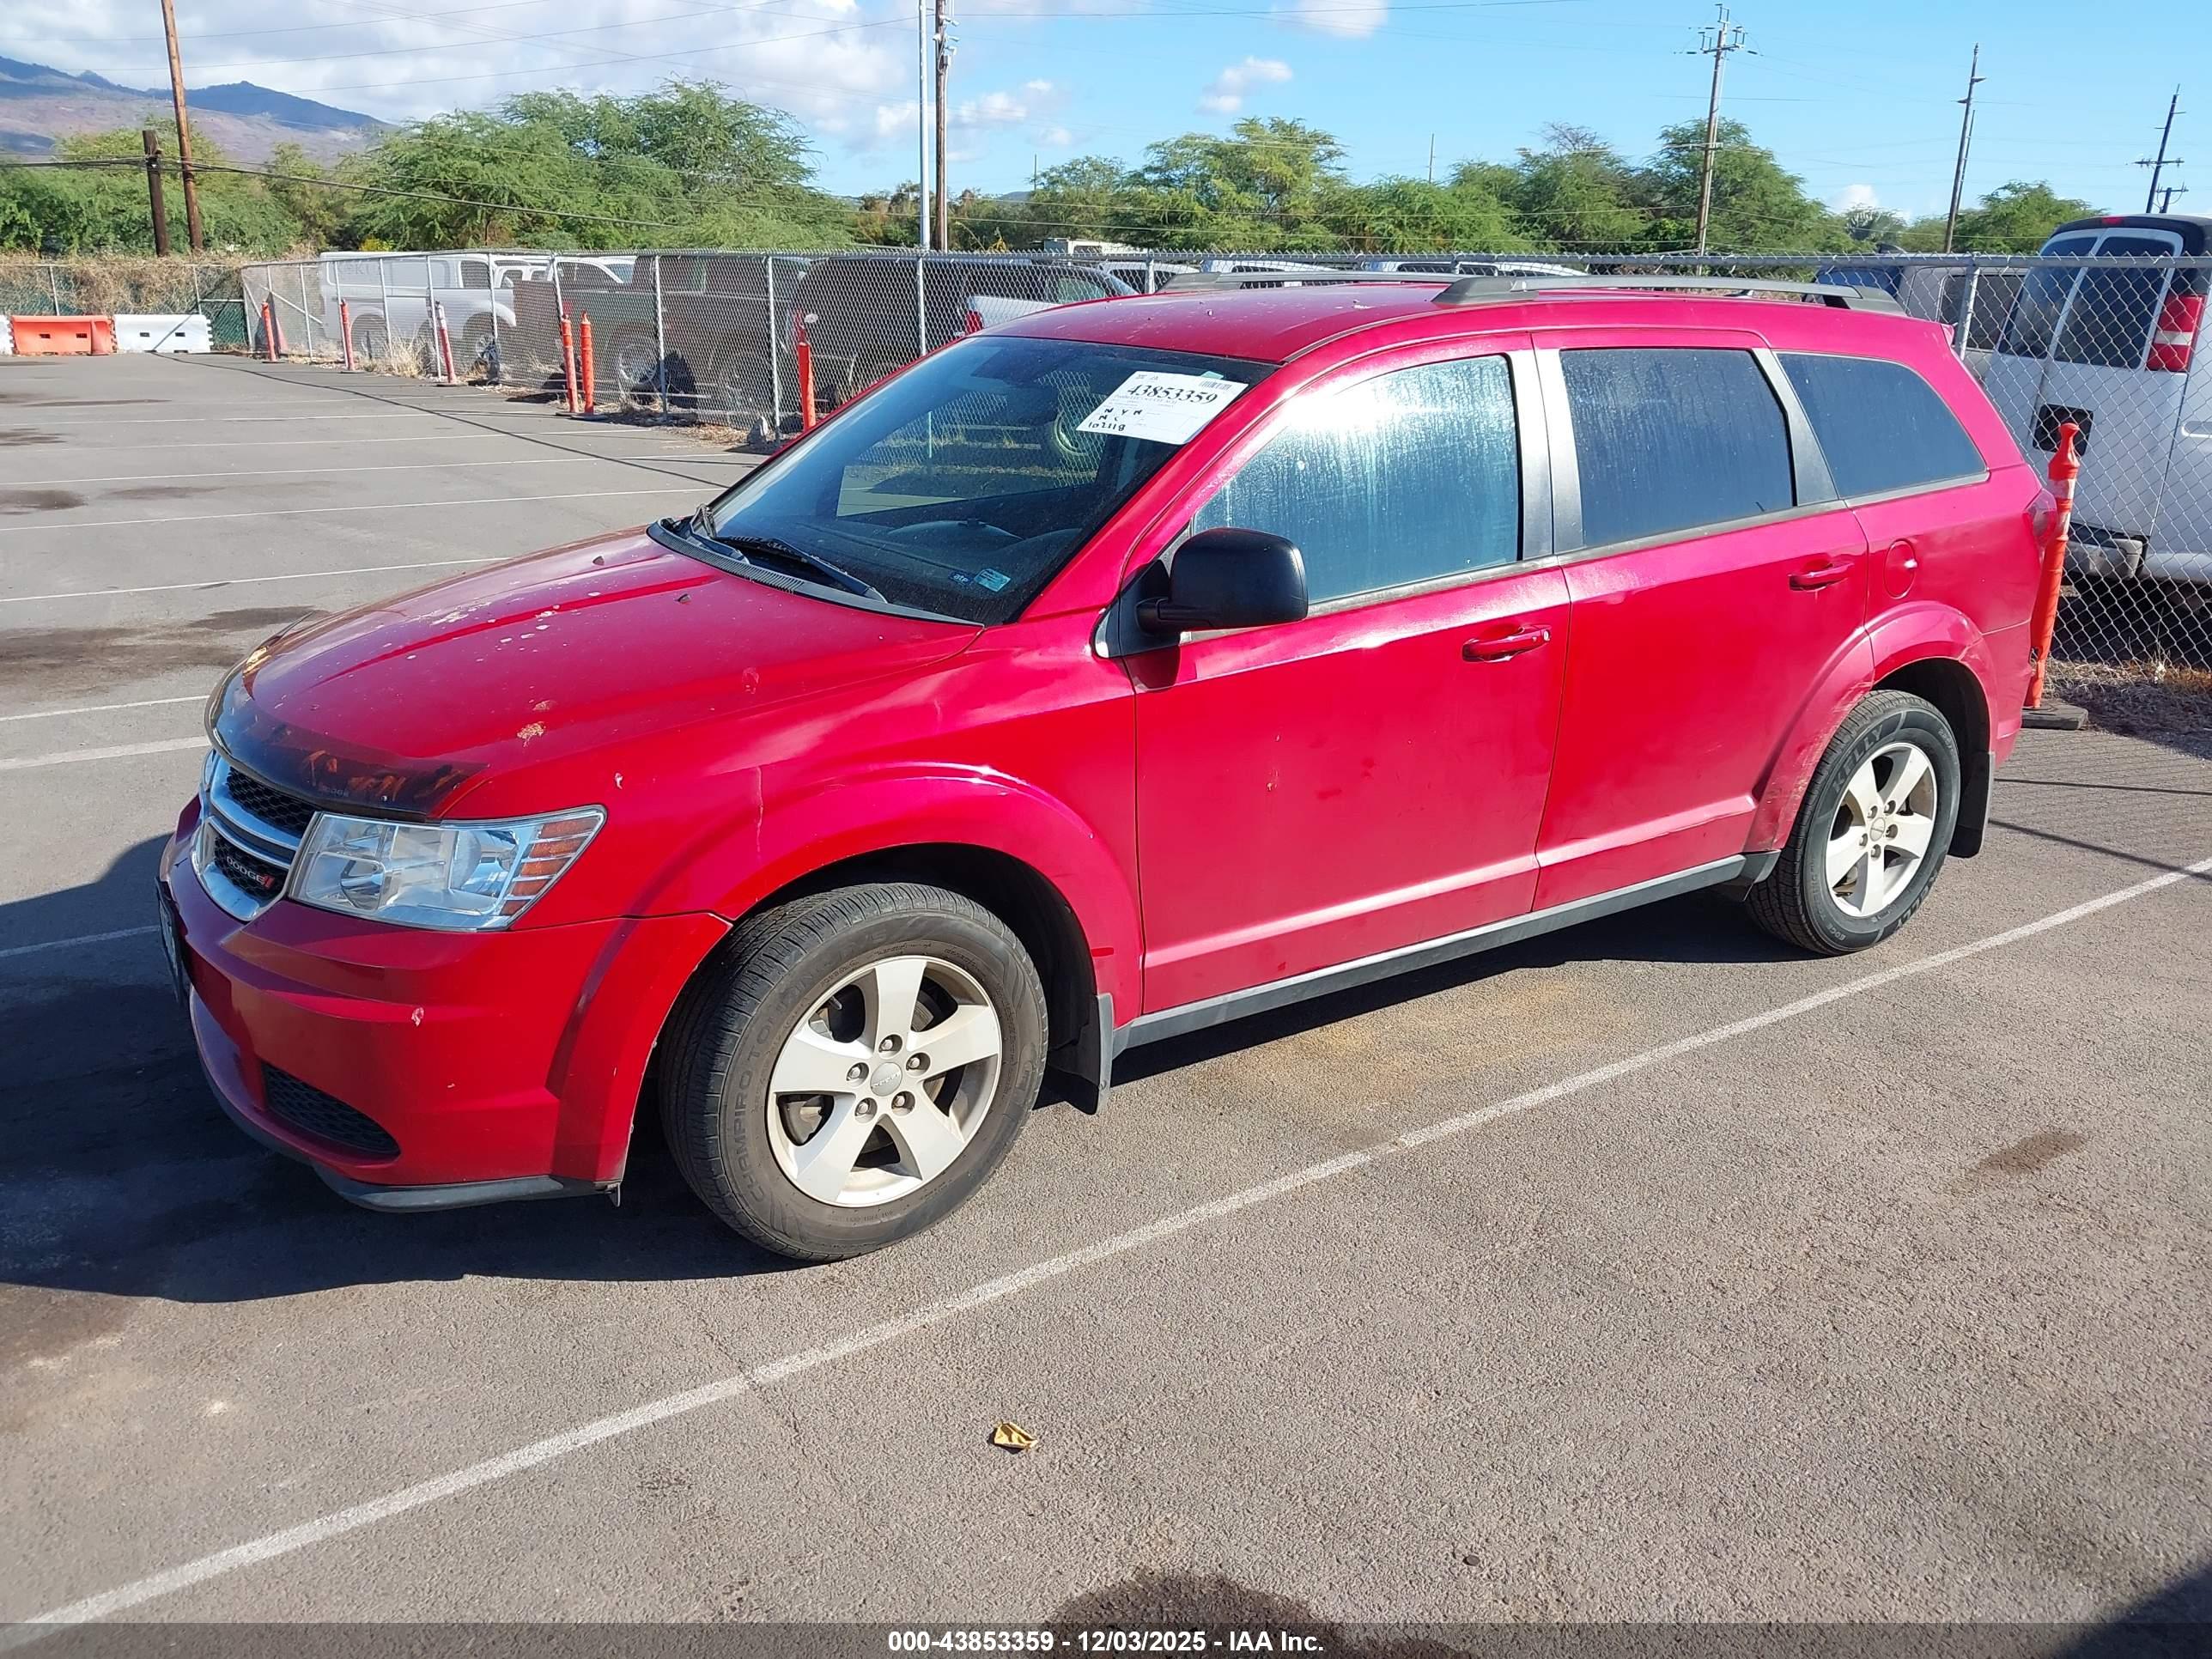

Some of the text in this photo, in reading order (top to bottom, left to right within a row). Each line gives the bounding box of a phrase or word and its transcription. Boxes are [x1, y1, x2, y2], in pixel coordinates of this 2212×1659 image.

[1127, 384, 1218, 404] 43853359
[1832, 723, 1885, 793] KELLY
[226, 855, 266, 886] DODGE
[1826, 922, 1847, 942] EDGE
[733, 1069, 766, 1203] CHAMPIRO
